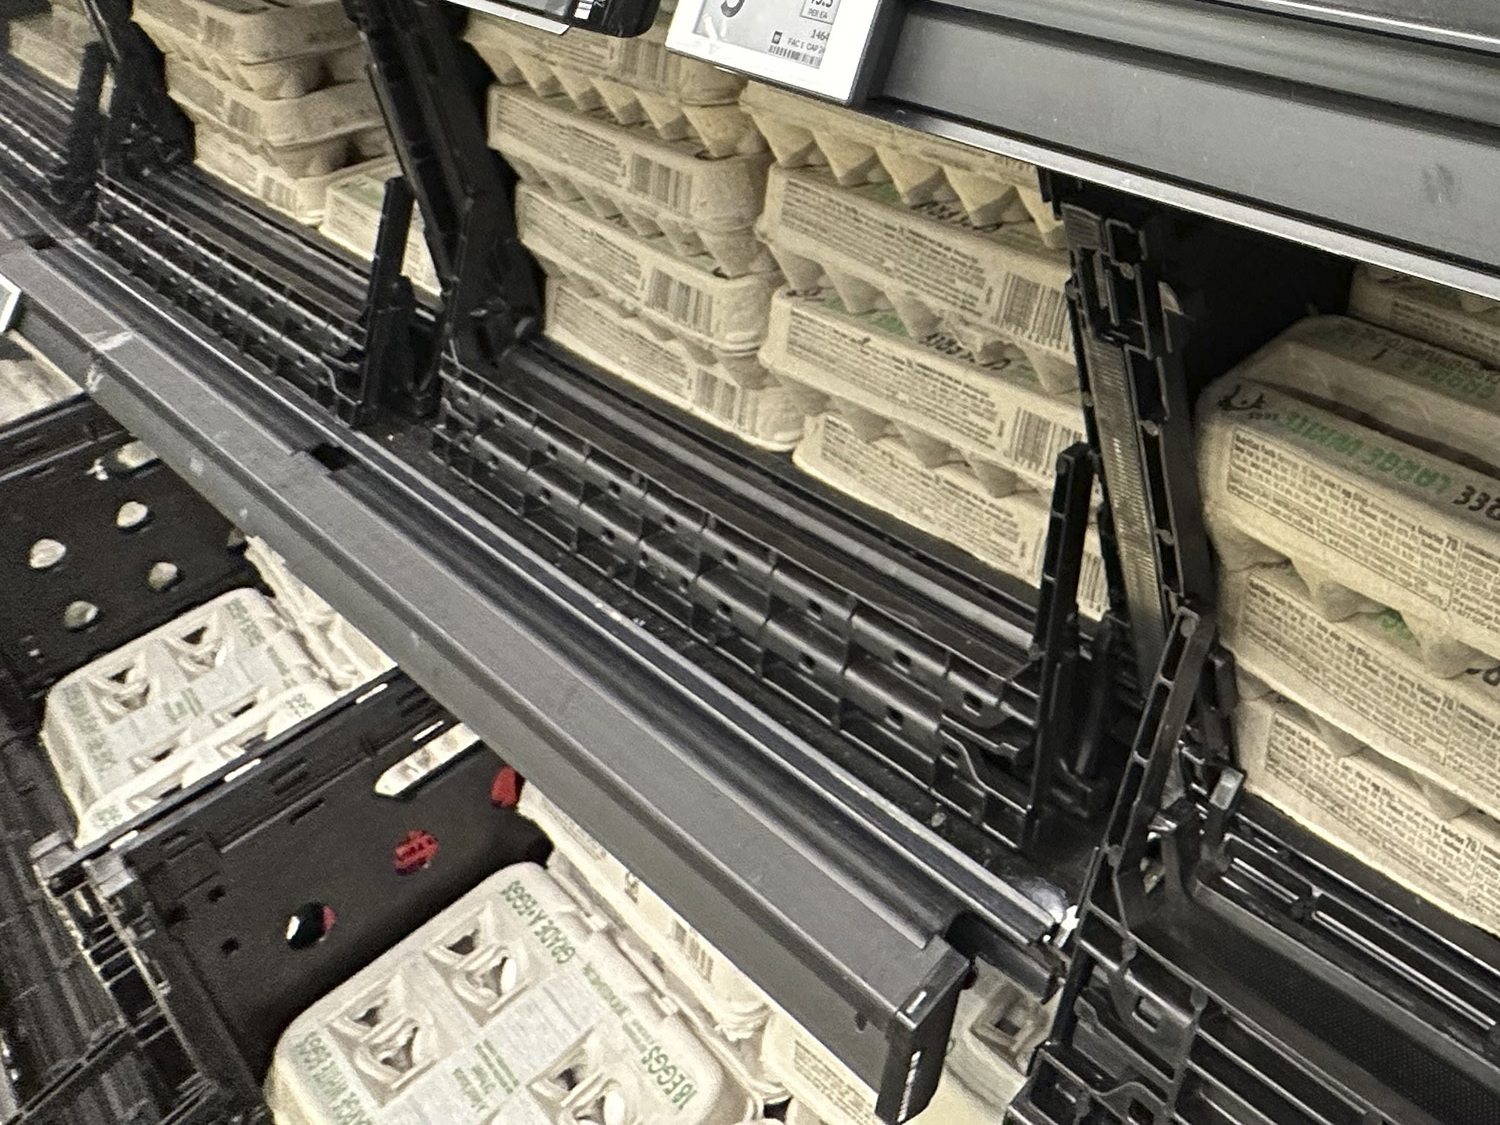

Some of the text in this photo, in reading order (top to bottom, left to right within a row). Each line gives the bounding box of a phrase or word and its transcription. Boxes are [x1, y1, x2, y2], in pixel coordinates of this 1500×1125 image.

[1365, 447, 1453, 494] LARGE
[534, 923, 577, 965] GRADE
[640, 1045, 698, 1111] 18 EGGS
